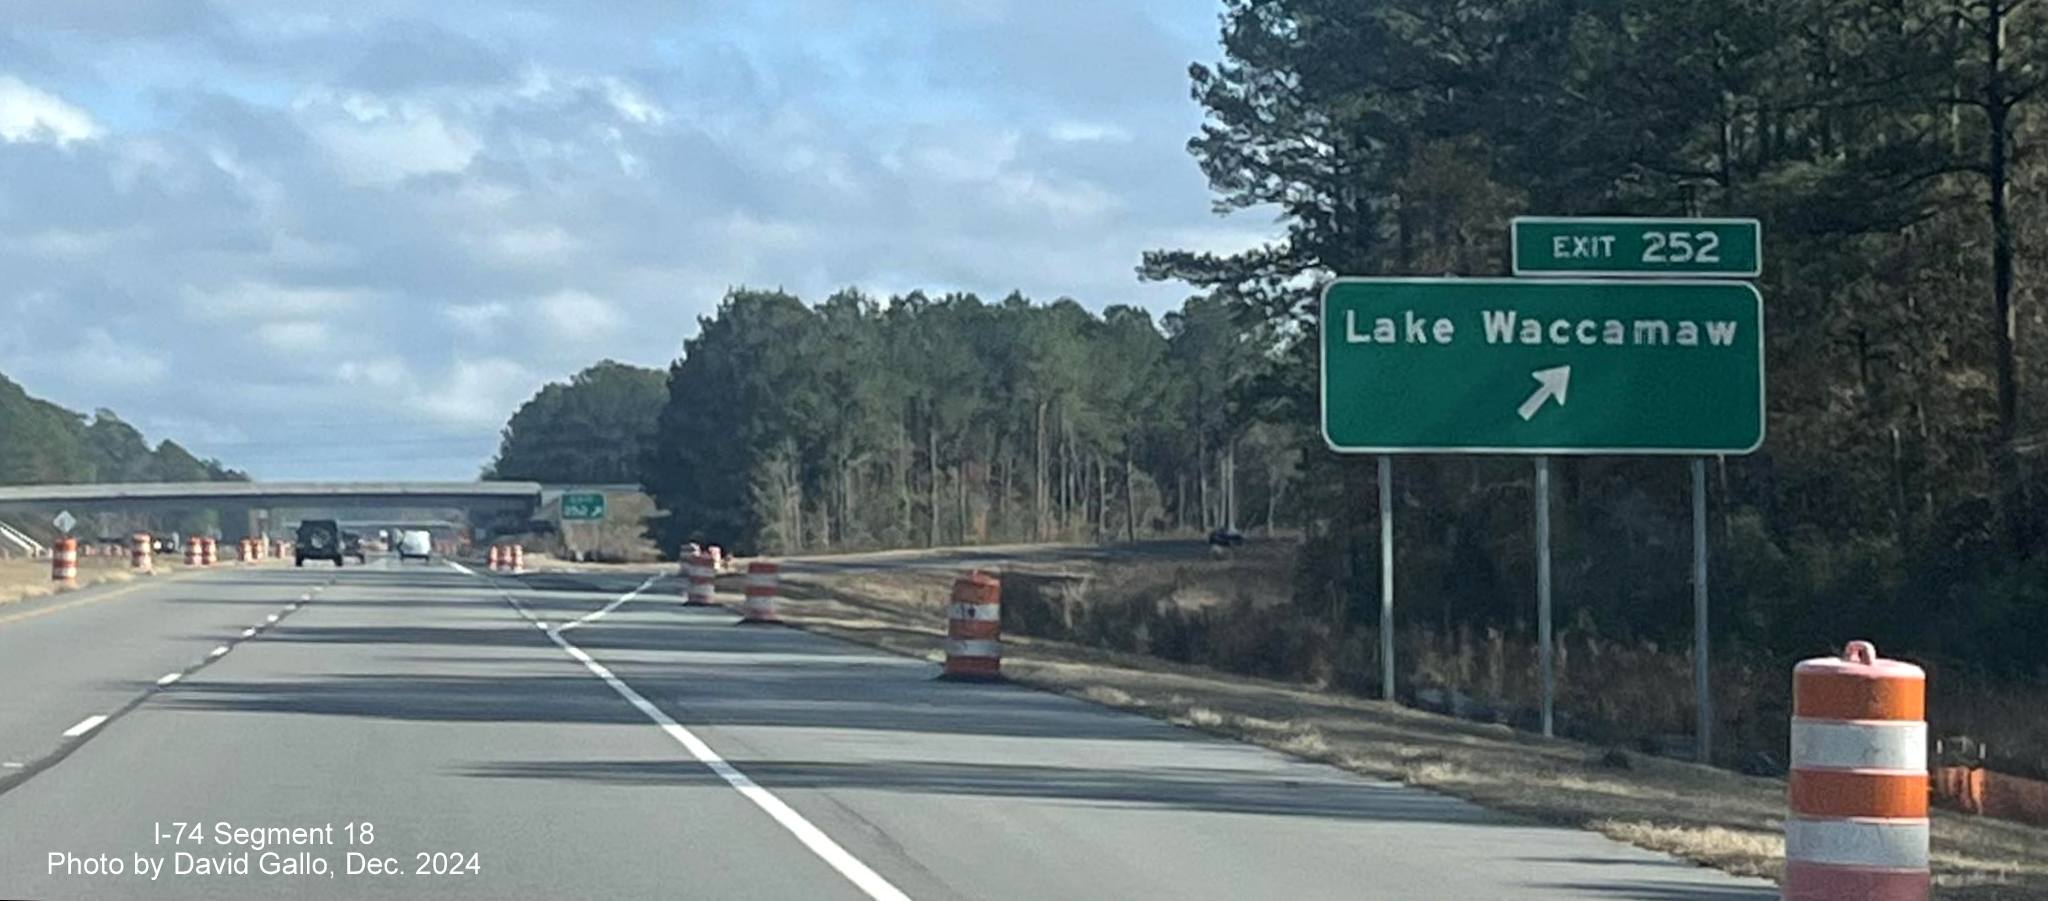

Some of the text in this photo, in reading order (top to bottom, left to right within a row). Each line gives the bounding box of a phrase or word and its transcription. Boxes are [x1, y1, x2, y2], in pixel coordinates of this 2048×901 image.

[1553, 232, 1719, 263] EXIT 252
[1346, 310, 1737, 346] Lake Waccamaw
